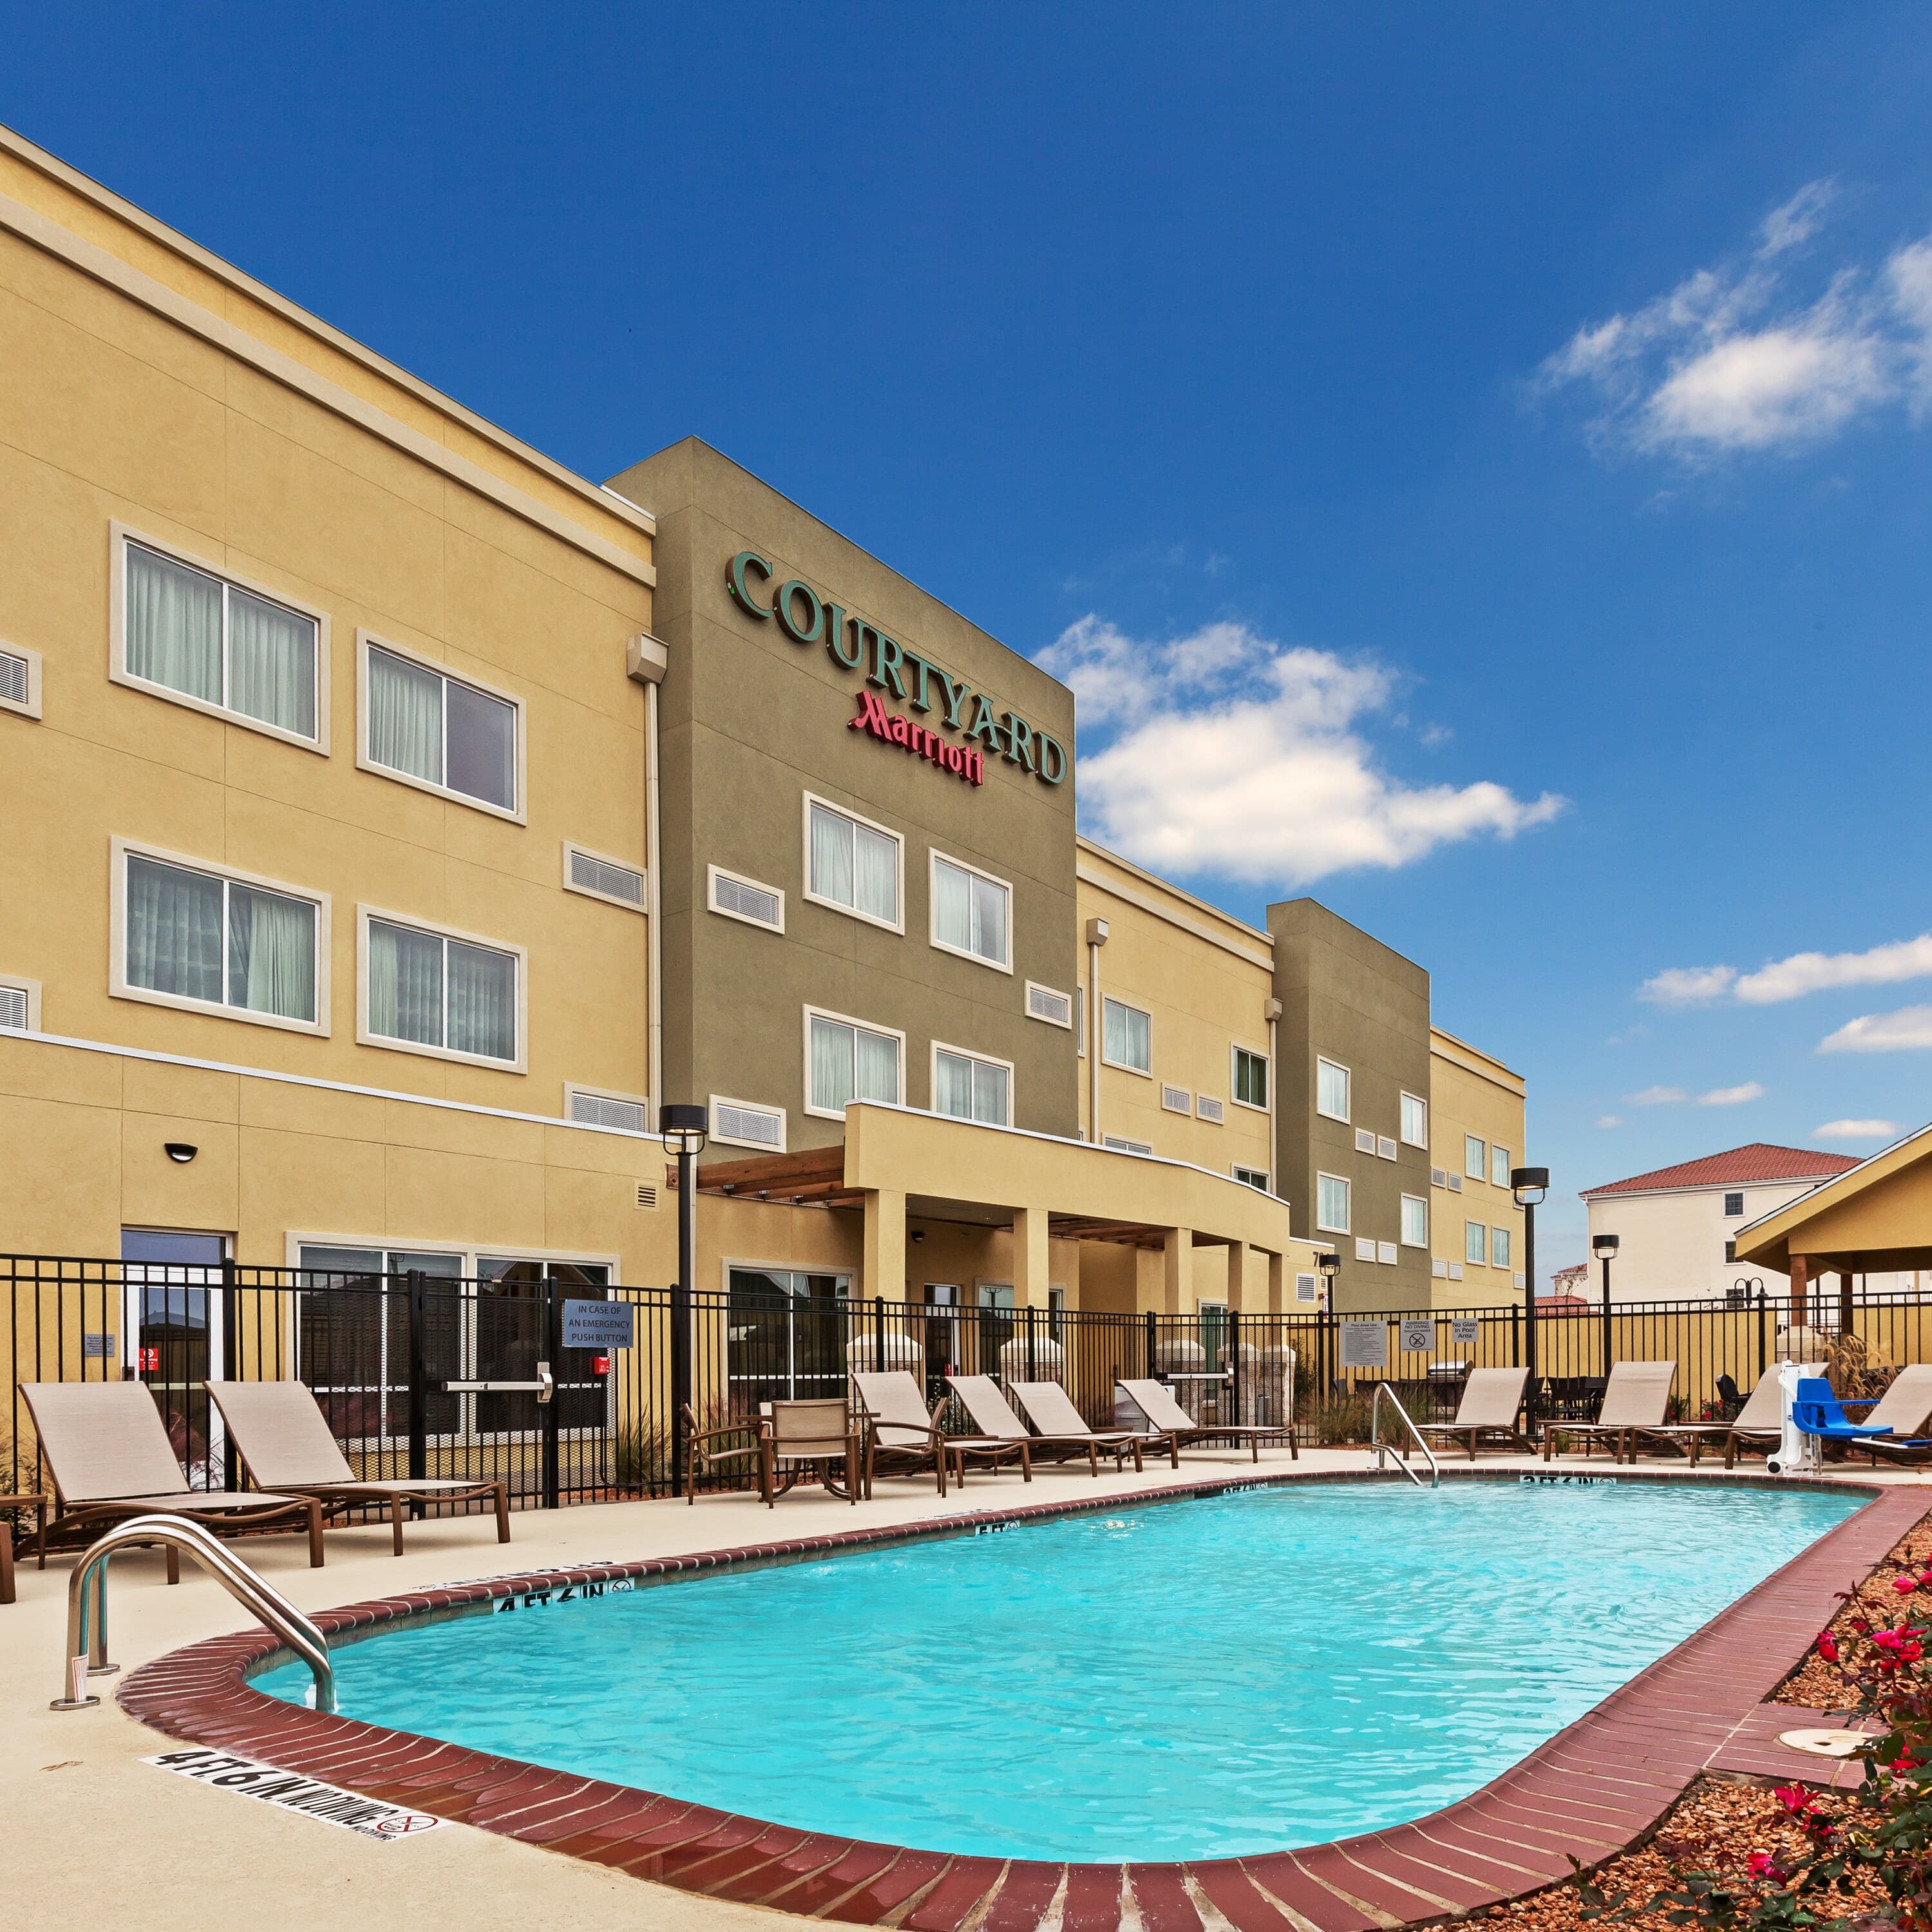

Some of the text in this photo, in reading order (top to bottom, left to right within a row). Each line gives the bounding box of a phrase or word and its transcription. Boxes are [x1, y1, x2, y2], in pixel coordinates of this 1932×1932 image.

[725, 551, 1067, 784] COURTYARD
[848, 690, 983, 786] Marriott
[589, 1305, 609, 1314] CASE
[611, 1306, 621, 1314] OF
[583, 1320, 630, 1329] EMERGENCY
[596, 1334, 627, 1342] BUTTON
[524, 1591, 551, 1607] FT
[583, 1583, 603, 1598] IN
[155, 1751, 216, 1765] 4
[172, 1757, 256, 1778] FT.
[212, 1770, 283, 1786] 6
[277, 1789, 343, 1806] NO
[299, 1796, 399, 1825] DIVING
[348, 1824, 397, 1841] NO DIVING
